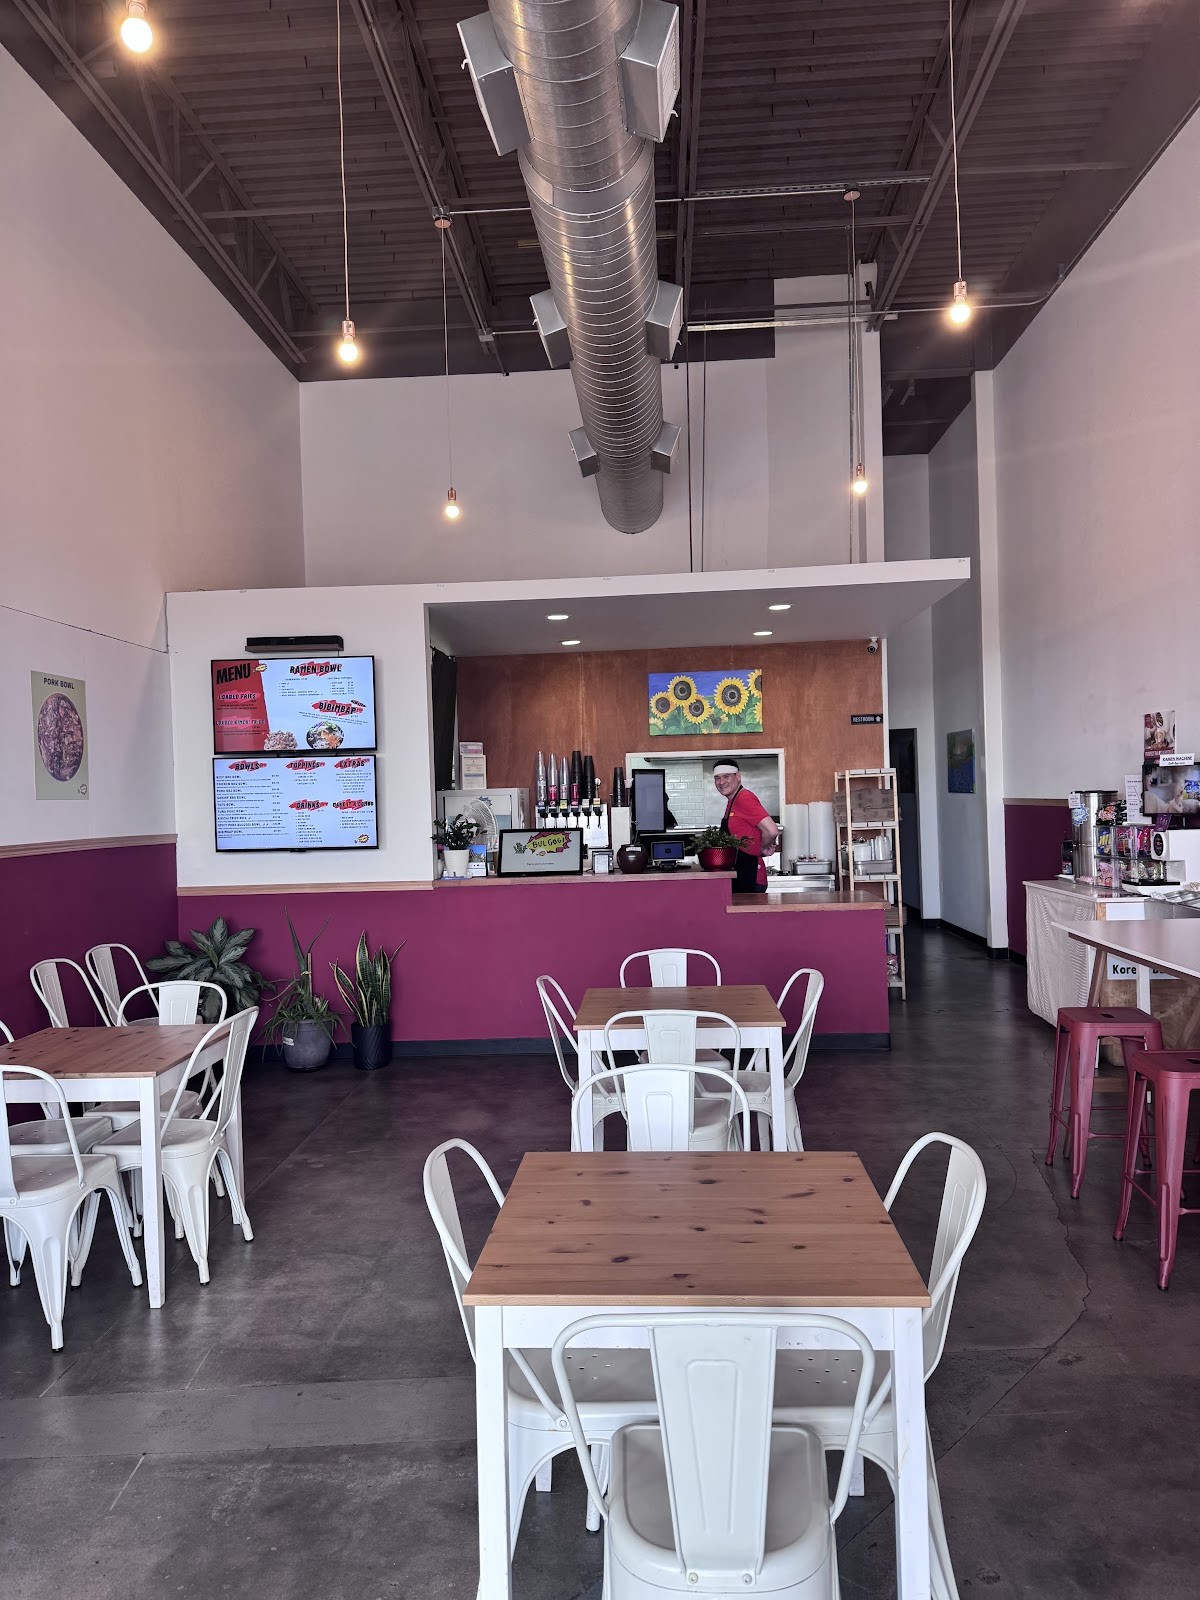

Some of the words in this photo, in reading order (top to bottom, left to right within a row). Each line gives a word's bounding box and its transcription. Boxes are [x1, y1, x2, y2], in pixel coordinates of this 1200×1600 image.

[216, 663, 251, 685] MENU
[290, 664, 317, 674] RAMEN
[320, 663, 342, 673] BOWL
[43, 677, 59, 687] PORK
[60, 680, 75, 690] BOWL
[319, 702, 357, 715] BIBIMBAP
[235, 762, 261, 771] BOWLS
[290, 761, 320, 769] TOPPINGS
[339, 759, 366, 768] EXTRAS
[532, 837, 565, 849] BULGOGI
[1112, 964, 1137, 975] Kore
